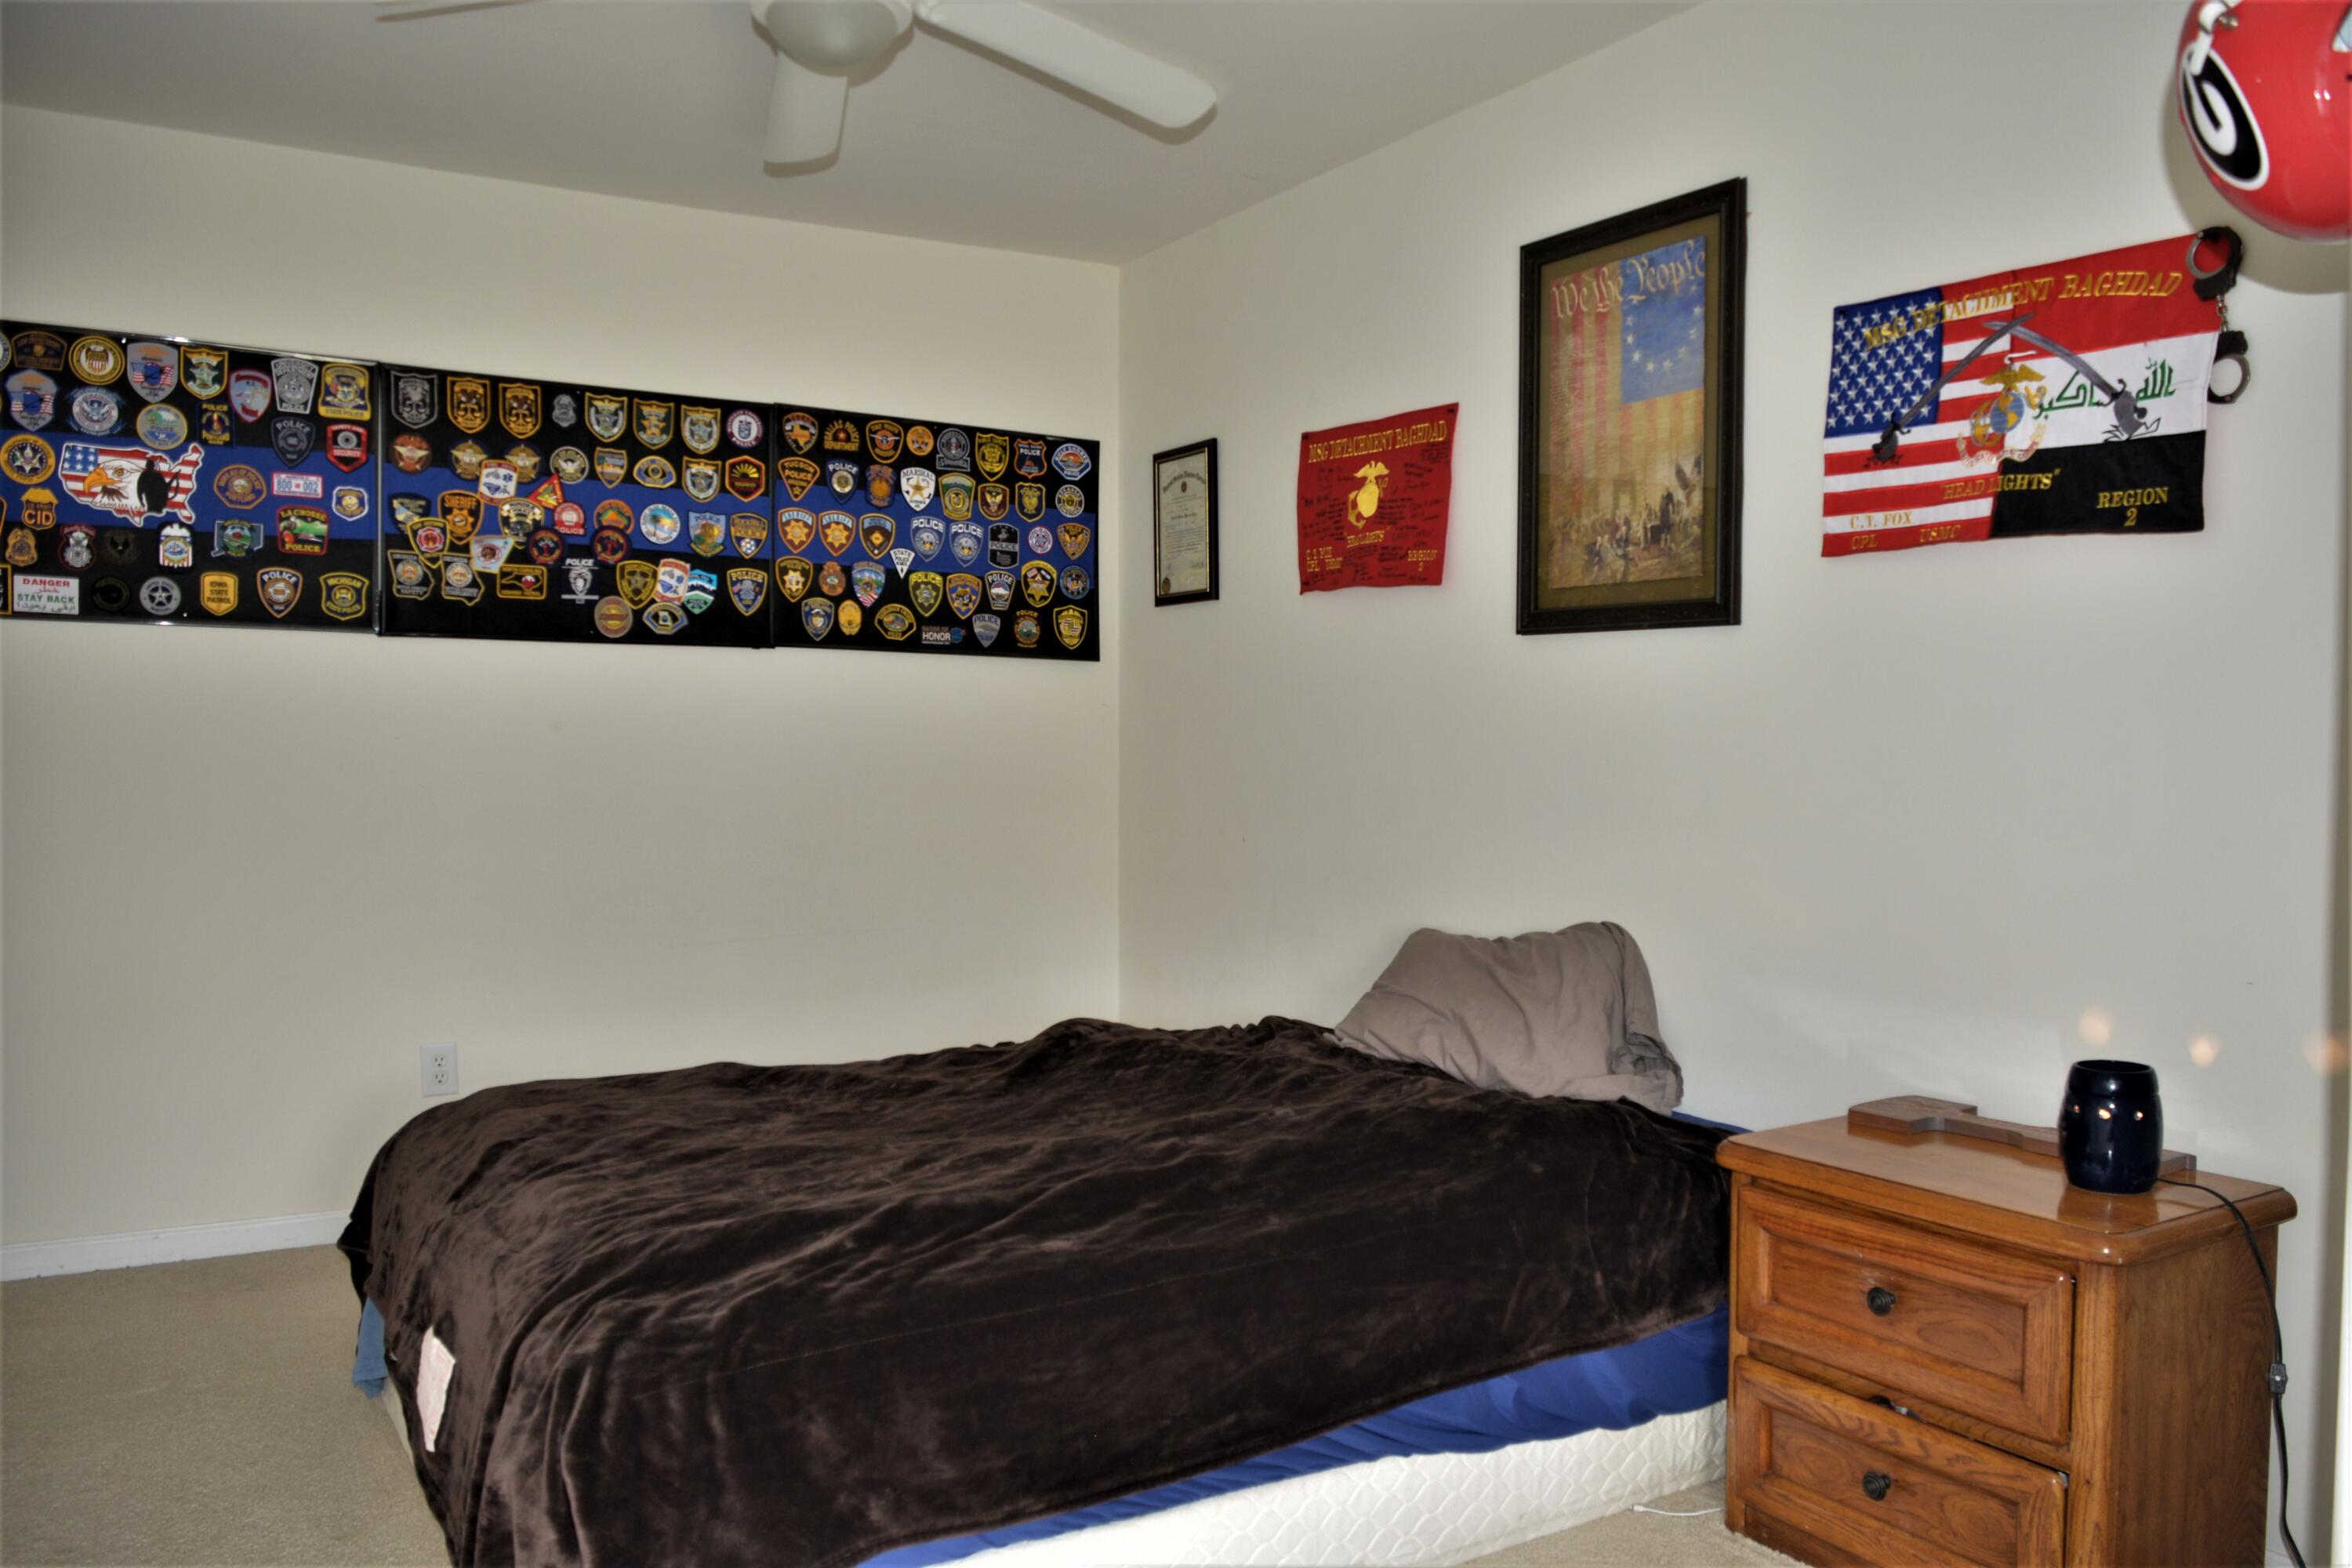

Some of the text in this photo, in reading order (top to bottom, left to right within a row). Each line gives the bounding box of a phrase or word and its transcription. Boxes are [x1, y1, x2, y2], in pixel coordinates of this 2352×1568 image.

[1551, 239, 1705, 318] We the People
[1864, 270, 2183, 351] MSG DETACHMENT BAGHDAD
[281, 402, 305, 412] POLICE
[276, 419, 310, 434] POLICE
[823, 441, 859, 452] DEPARTMENT
[1308, 420, 1448, 463] MSG DETACHMENT BAGHDAD
[333, 448, 361, 458] SECURITY
[1020, 448, 1041, 456] POLICE
[784, 461, 815, 473] TUCSON
[828, 463, 858, 475] POLICE
[785, 470, 813, 481] POLICE
[902, 470, 935, 481] MARSHAL
[1988, 468, 2061, 494] LIGHTS"
[276, 478, 319, 492] 800 002
[444, 495, 477, 510] SHERIFF
[2096, 487, 2169, 509] REGION
[24, 510, 53, 525] CID
[280, 510, 292, 518] LA
[293, 510, 327, 521] CROSSE
[782, 511, 811, 524] SHERIFF
[823, 514, 852, 526] SHERIFF
[1849, 511, 1912, 530] C.T. FOX
[2124, 508, 2138, 527] 2
[555, 526, 585, 535] POLICE
[913, 518, 945, 533] POLICE
[951, 524, 983, 539] POLICE
[1852, 524, 1962, 550] CPL USMC
[285, 543, 321, 553] POLICE
[990, 542, 1018, 551] POLICE
[1408, 550, 1437, 561] REGION
[23, 578, 70, 587] DANGER
[262, 572, 298, 584] POLICE
[326, 577, 362, 589] MICHIGAN
[731, 572, 764, 583] POLICE
[910, 573, 942, 586] POLICE
[987, 574, 1013, 586] POLICE
[17, 593, 75, 604] STAY BACK
[1016, 609, 1038, 618] POLICE
[974, 615, 999, 626] POLICE
[922, 631, 951, 641] HONOR
